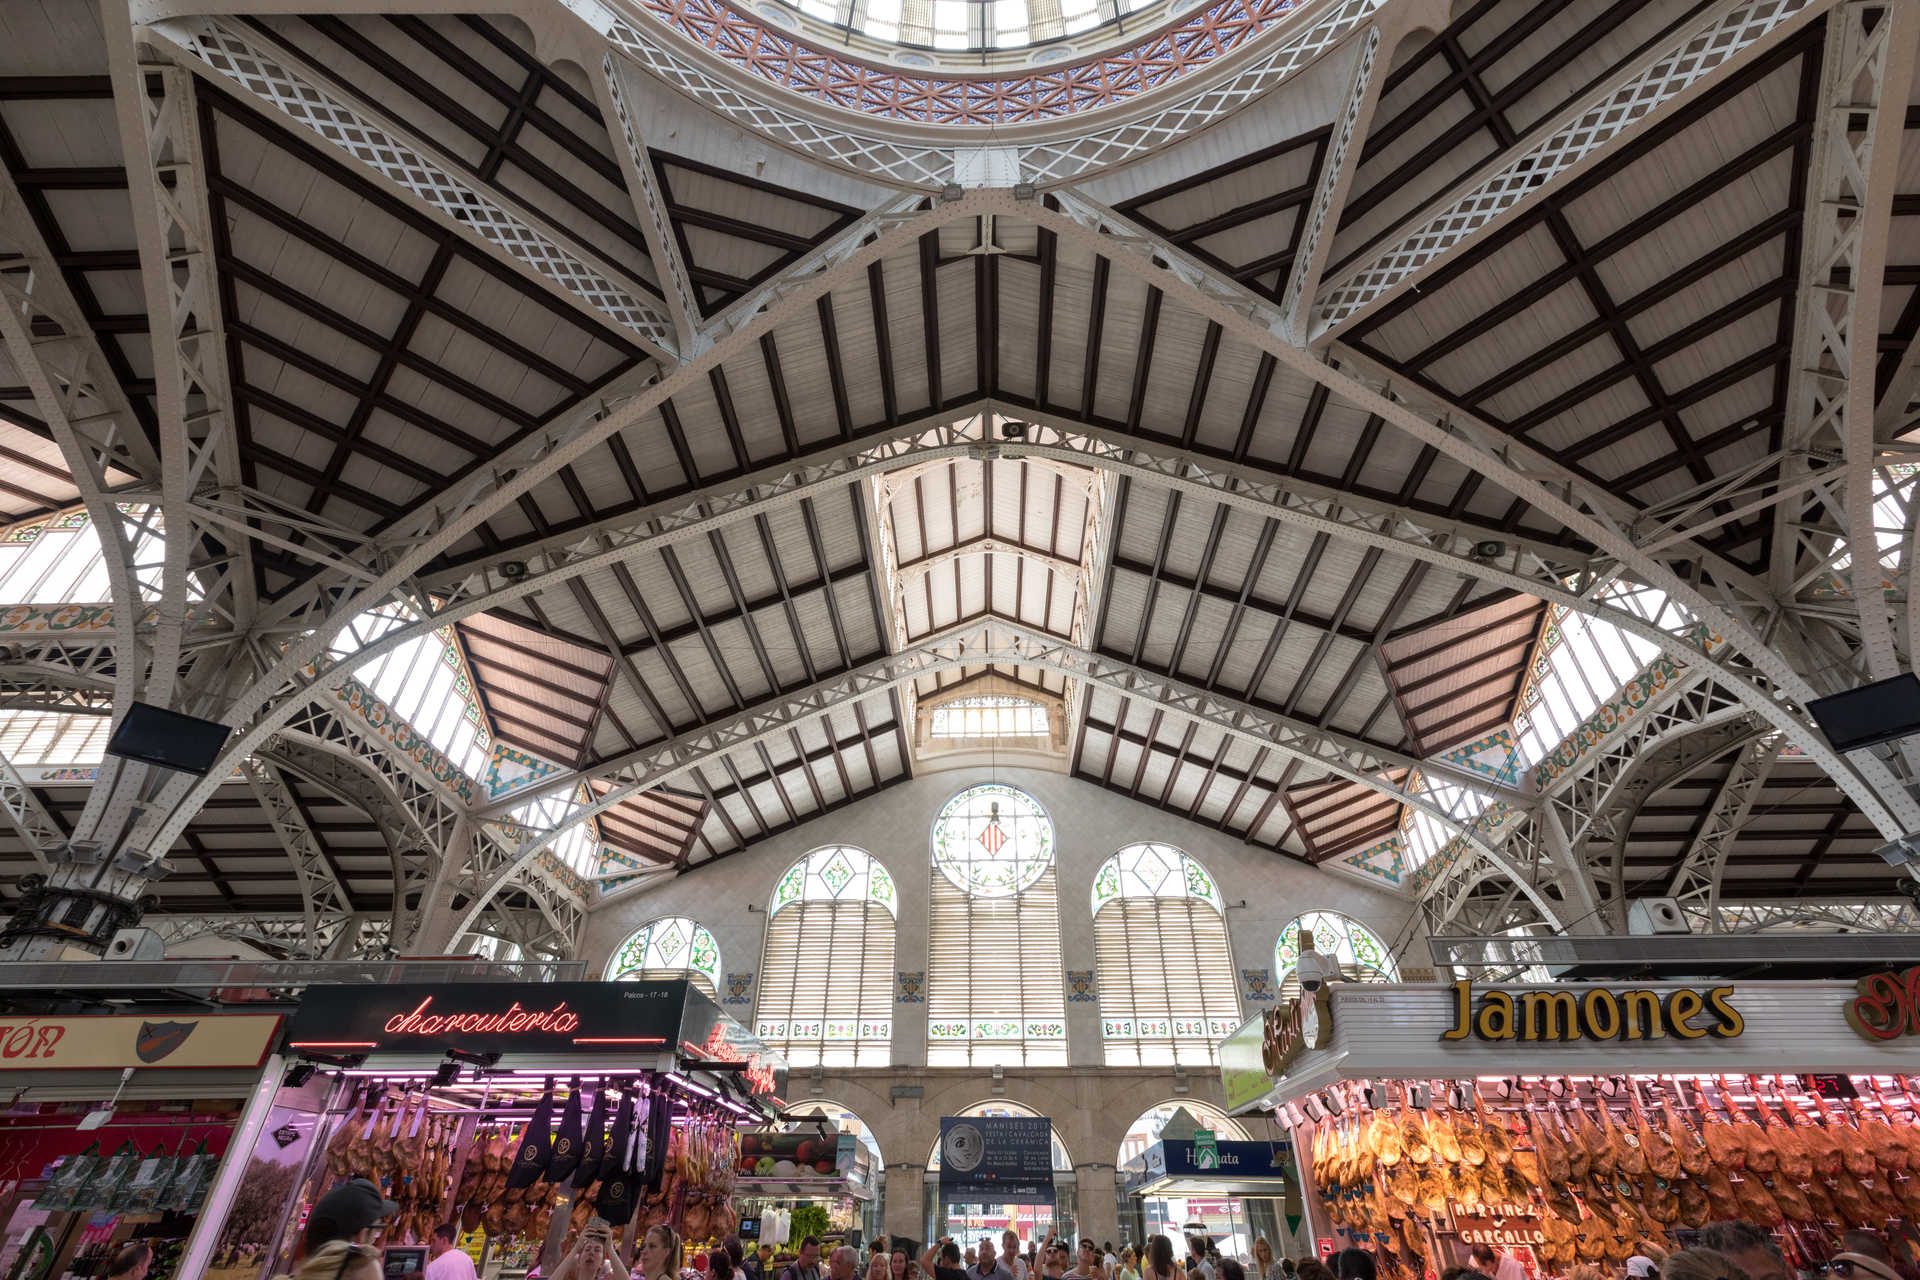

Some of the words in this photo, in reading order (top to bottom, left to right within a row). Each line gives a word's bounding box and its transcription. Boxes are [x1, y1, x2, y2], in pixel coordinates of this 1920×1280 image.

[384, 995, 579, 1034] charcutería
[1441, 980, 1745, 1040] Jamones
[1816, 1079, 1840, 1094] 27
[985, 1121, 1024, 1130] MANISES
[1027, 1121, 1049, 1130] 2017
[1461, 1229, 1545, 1244] GARGALLO
